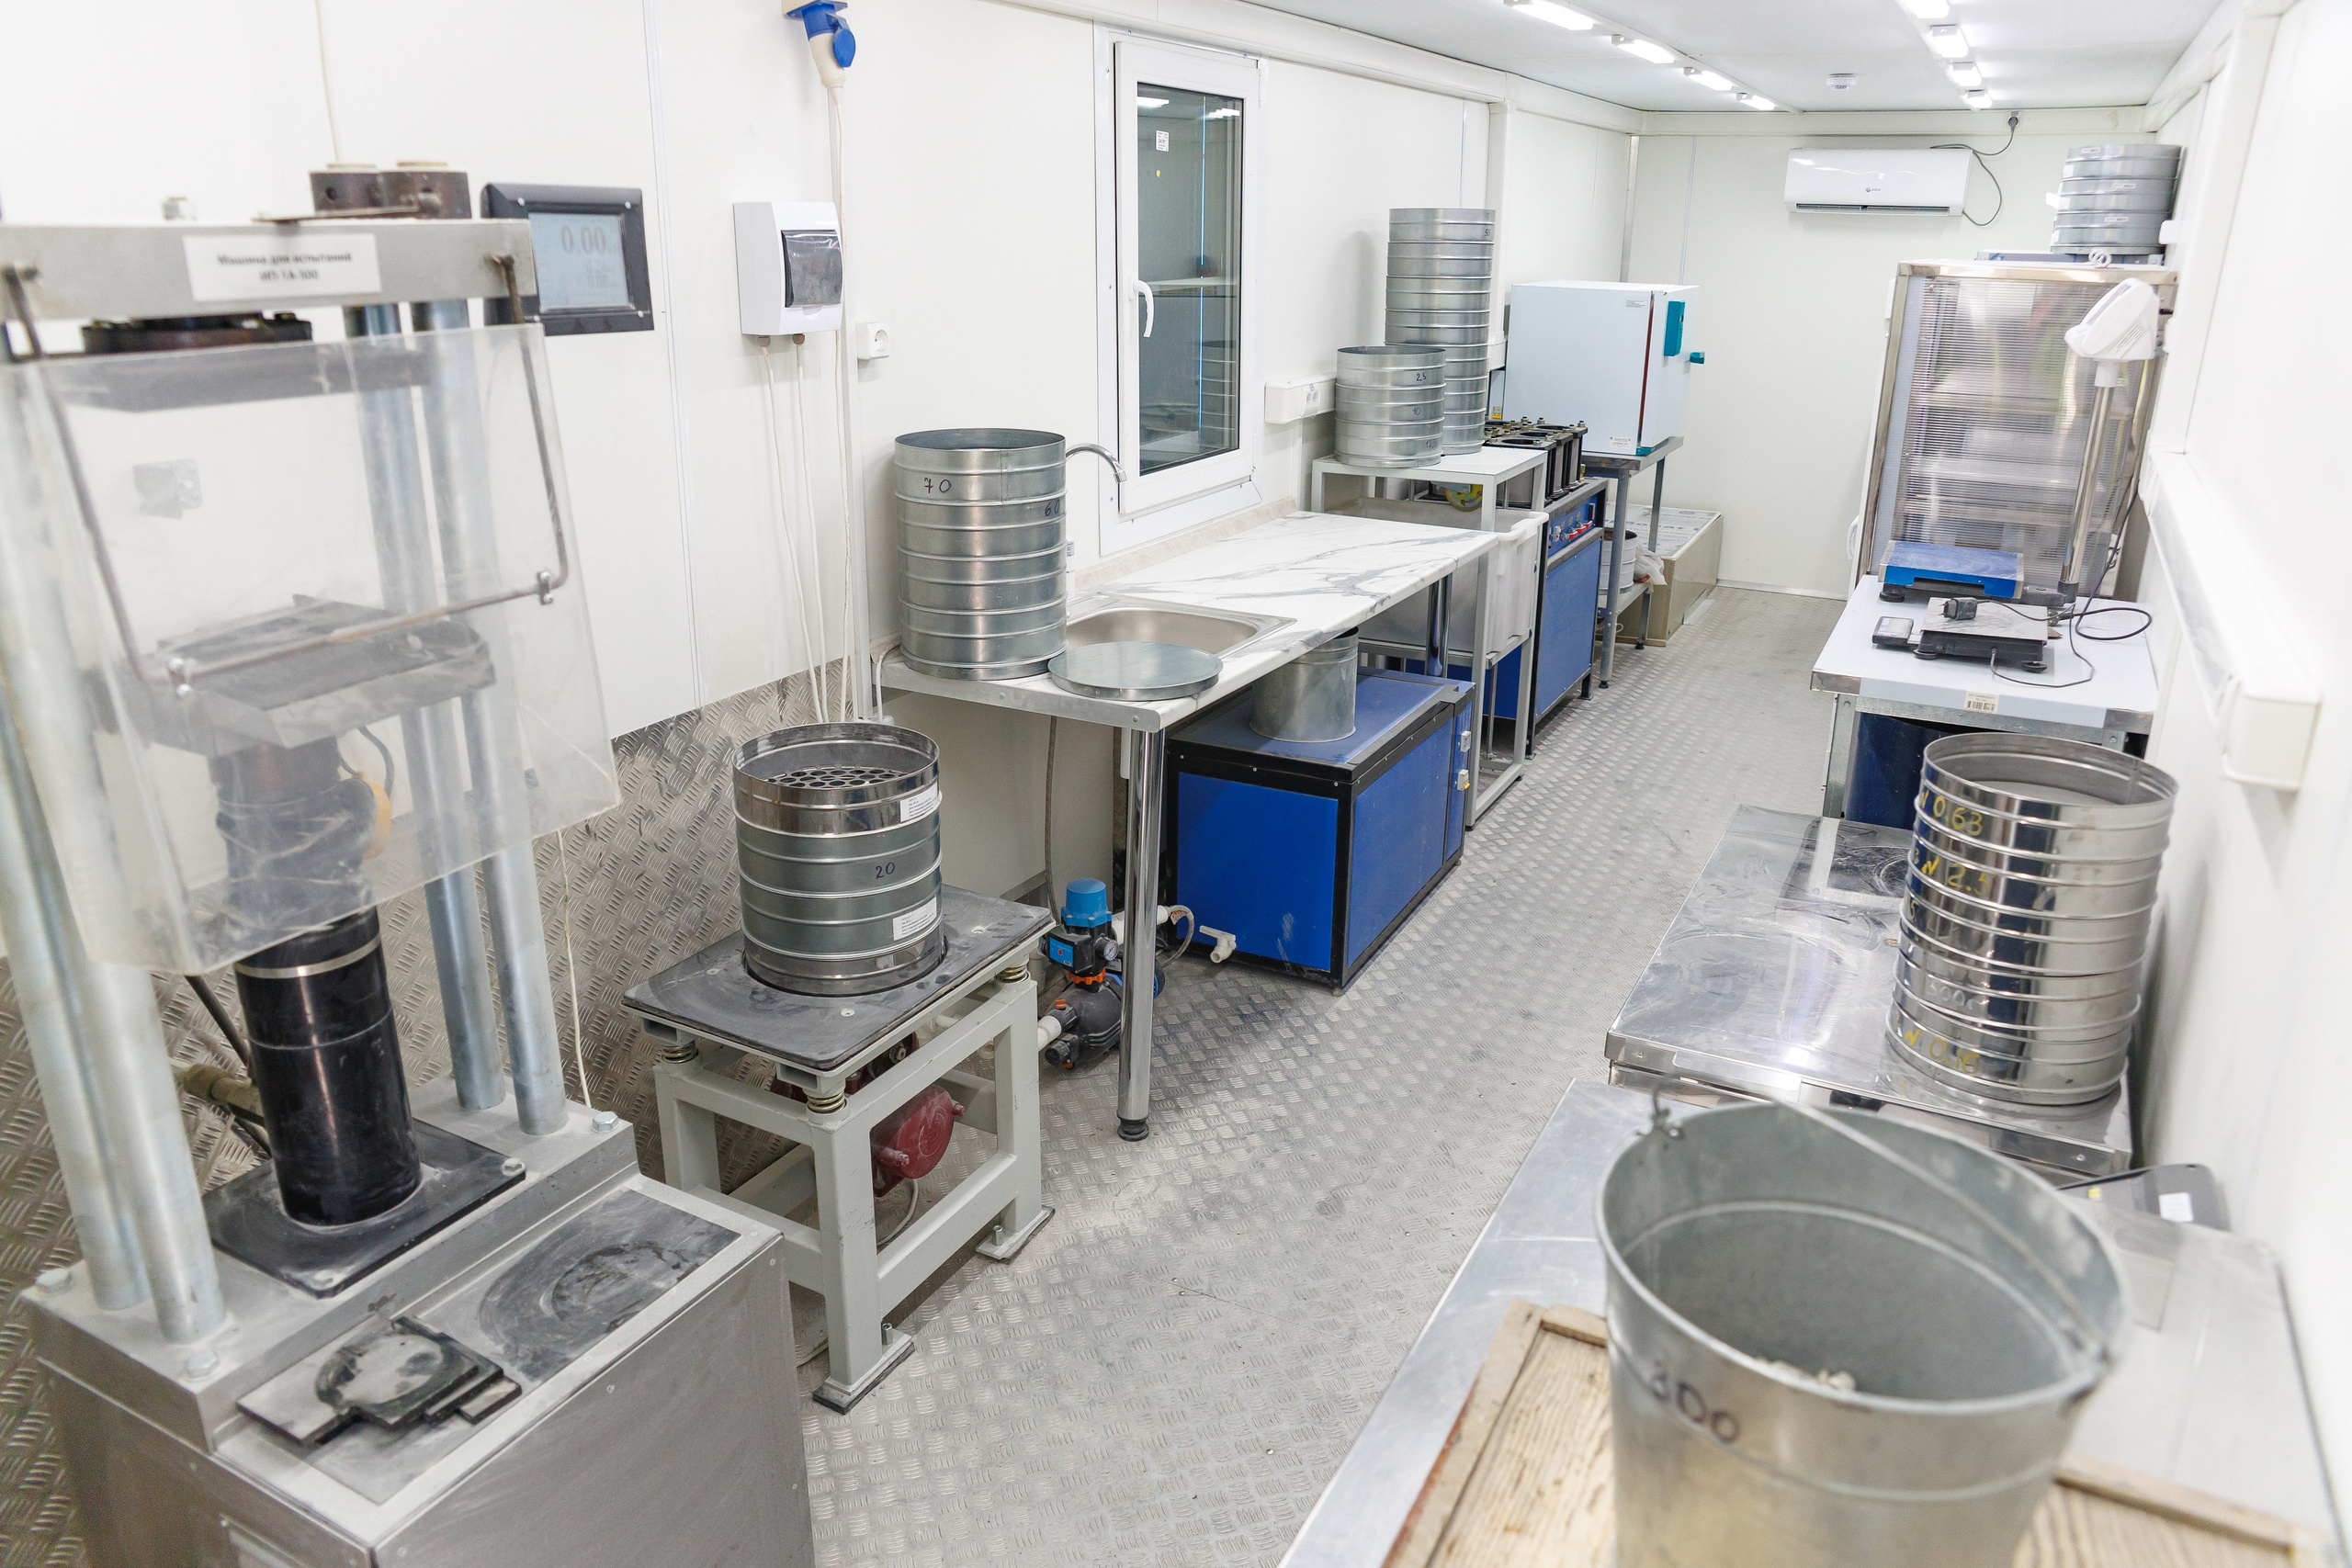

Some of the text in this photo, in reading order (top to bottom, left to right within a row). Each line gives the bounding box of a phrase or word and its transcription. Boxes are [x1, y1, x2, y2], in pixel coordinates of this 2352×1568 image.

[561, 225, 606, 254] 0.00
[923, 477, 952, 494] 70
[1045, 499, 1060, 517] 60
[1933, 795, 1983, 836] 0.63
[876, 862, 895, 879] 20
[1929, 1037, 1981, 1074] 0.16
